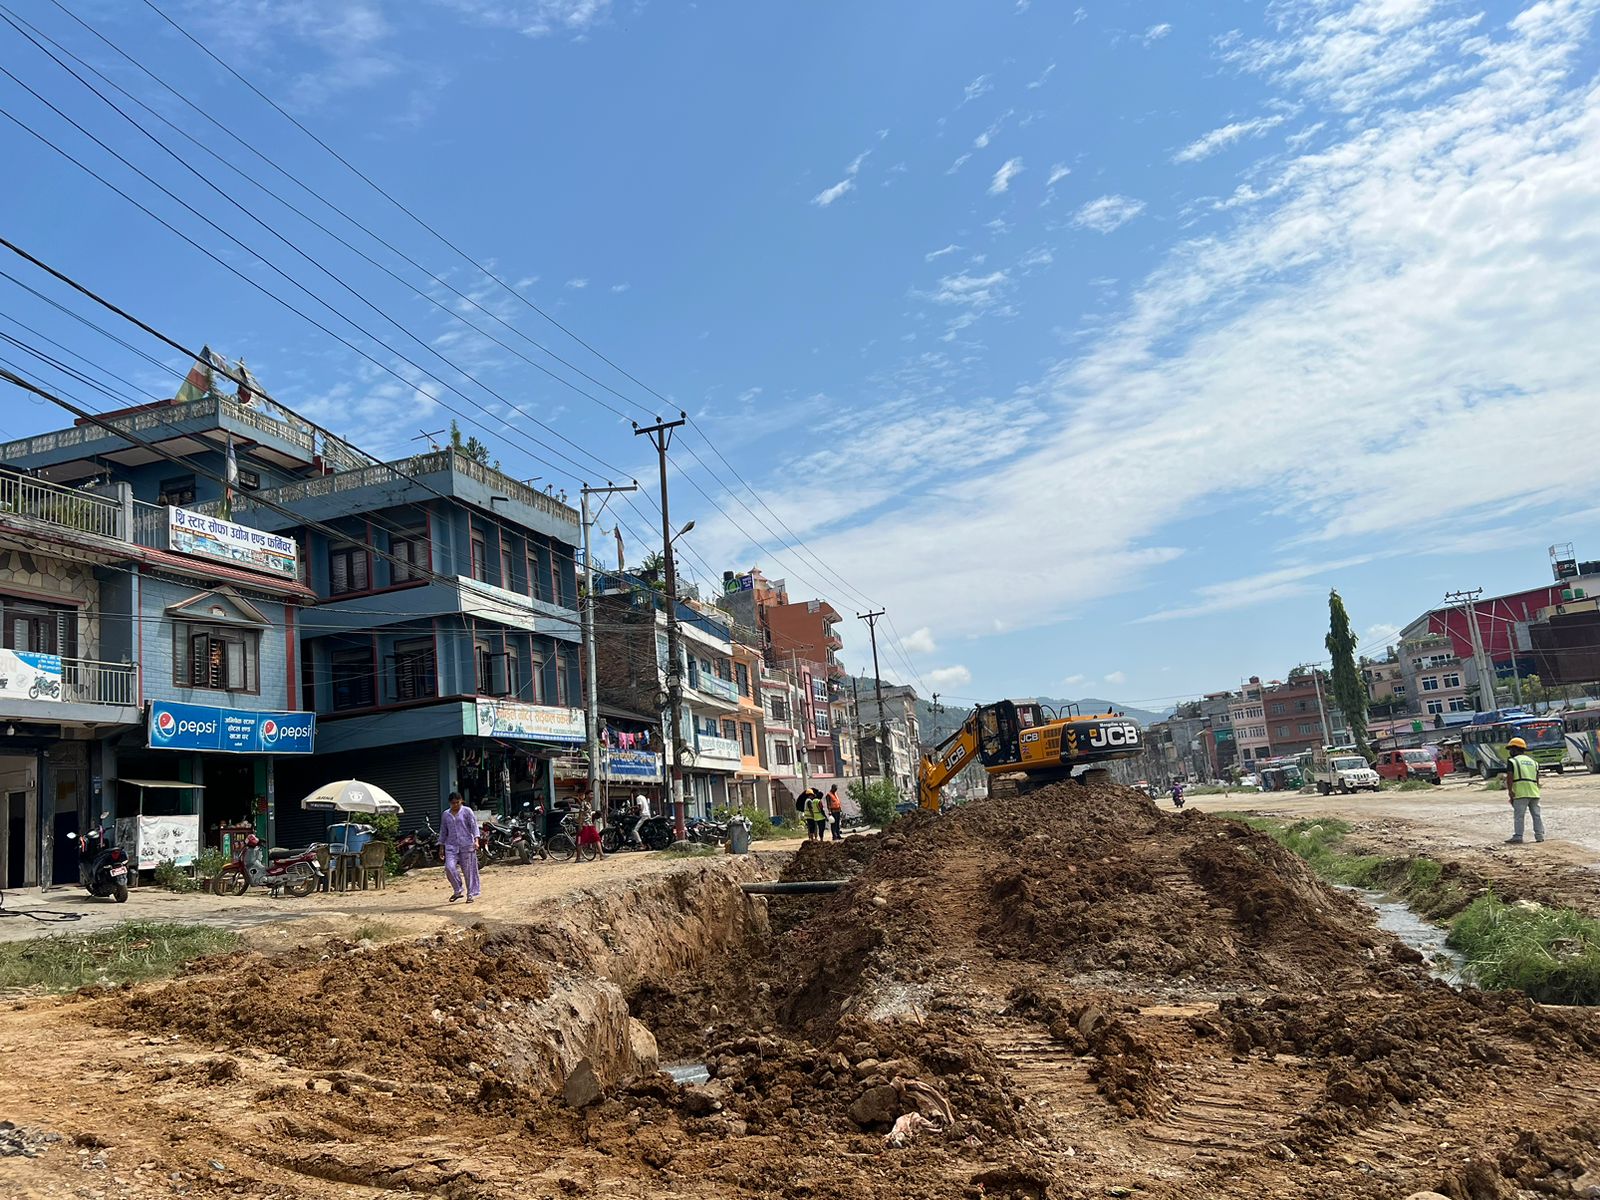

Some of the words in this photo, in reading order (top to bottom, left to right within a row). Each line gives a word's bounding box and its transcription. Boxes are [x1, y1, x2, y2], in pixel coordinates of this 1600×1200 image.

[188, 515, 206, 531] स्टार
[208, 519, 228, 536] सोफा
[230, 526, 249, 542] उद्योग
[251, 532, 266, 546] एण्ड
[178, 719, 217, 736] pepsi
[280, 724, 311, 739] pepsi
[1090, 726, 1138, 747] JCB
[1020, 732, 1038, 743] JCB
[945, 745, 966, 770] JCB
